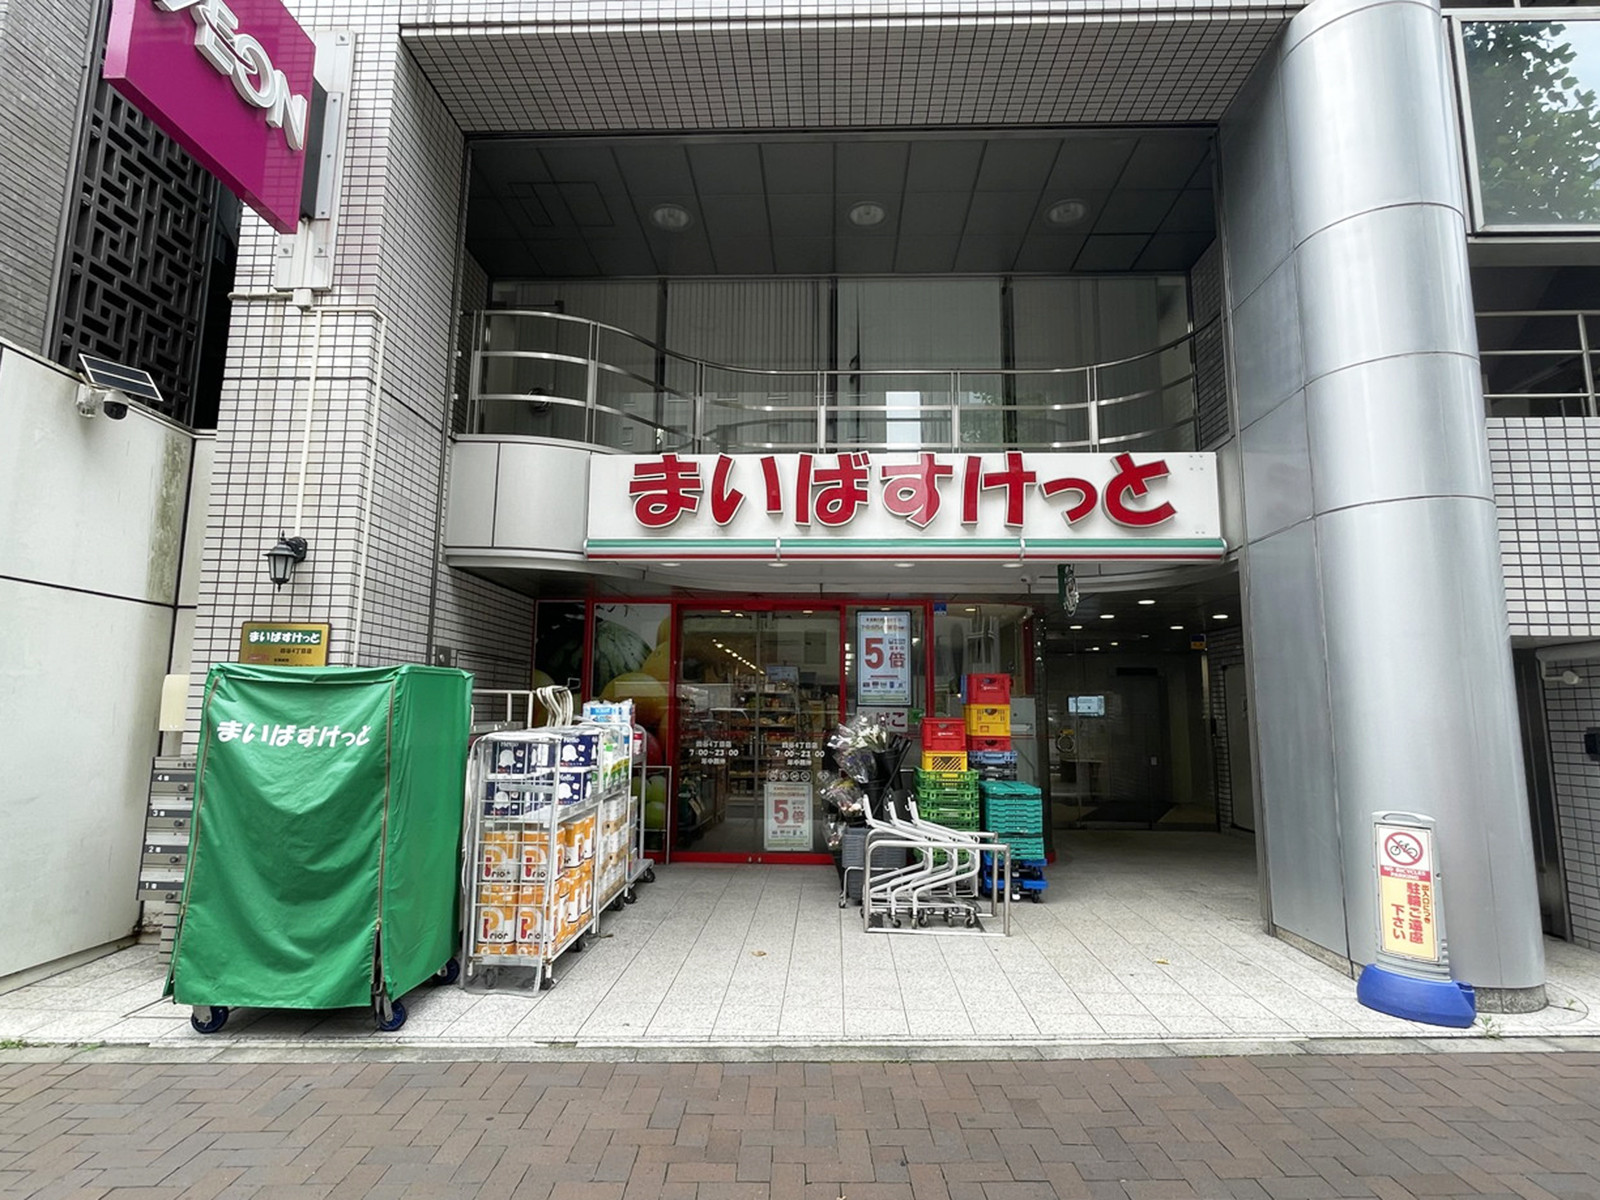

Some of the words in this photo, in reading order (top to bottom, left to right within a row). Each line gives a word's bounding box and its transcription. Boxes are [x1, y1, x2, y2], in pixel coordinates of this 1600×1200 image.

[154, 0, 307, 151] EON
[629, 451, 1178, 529] まいばすけっと
[249, 631, 320, 644] まいばすけっと
[217, 721, 372, 748] まいばすけっと
[1391, 903, 1406, 940] 下さい
